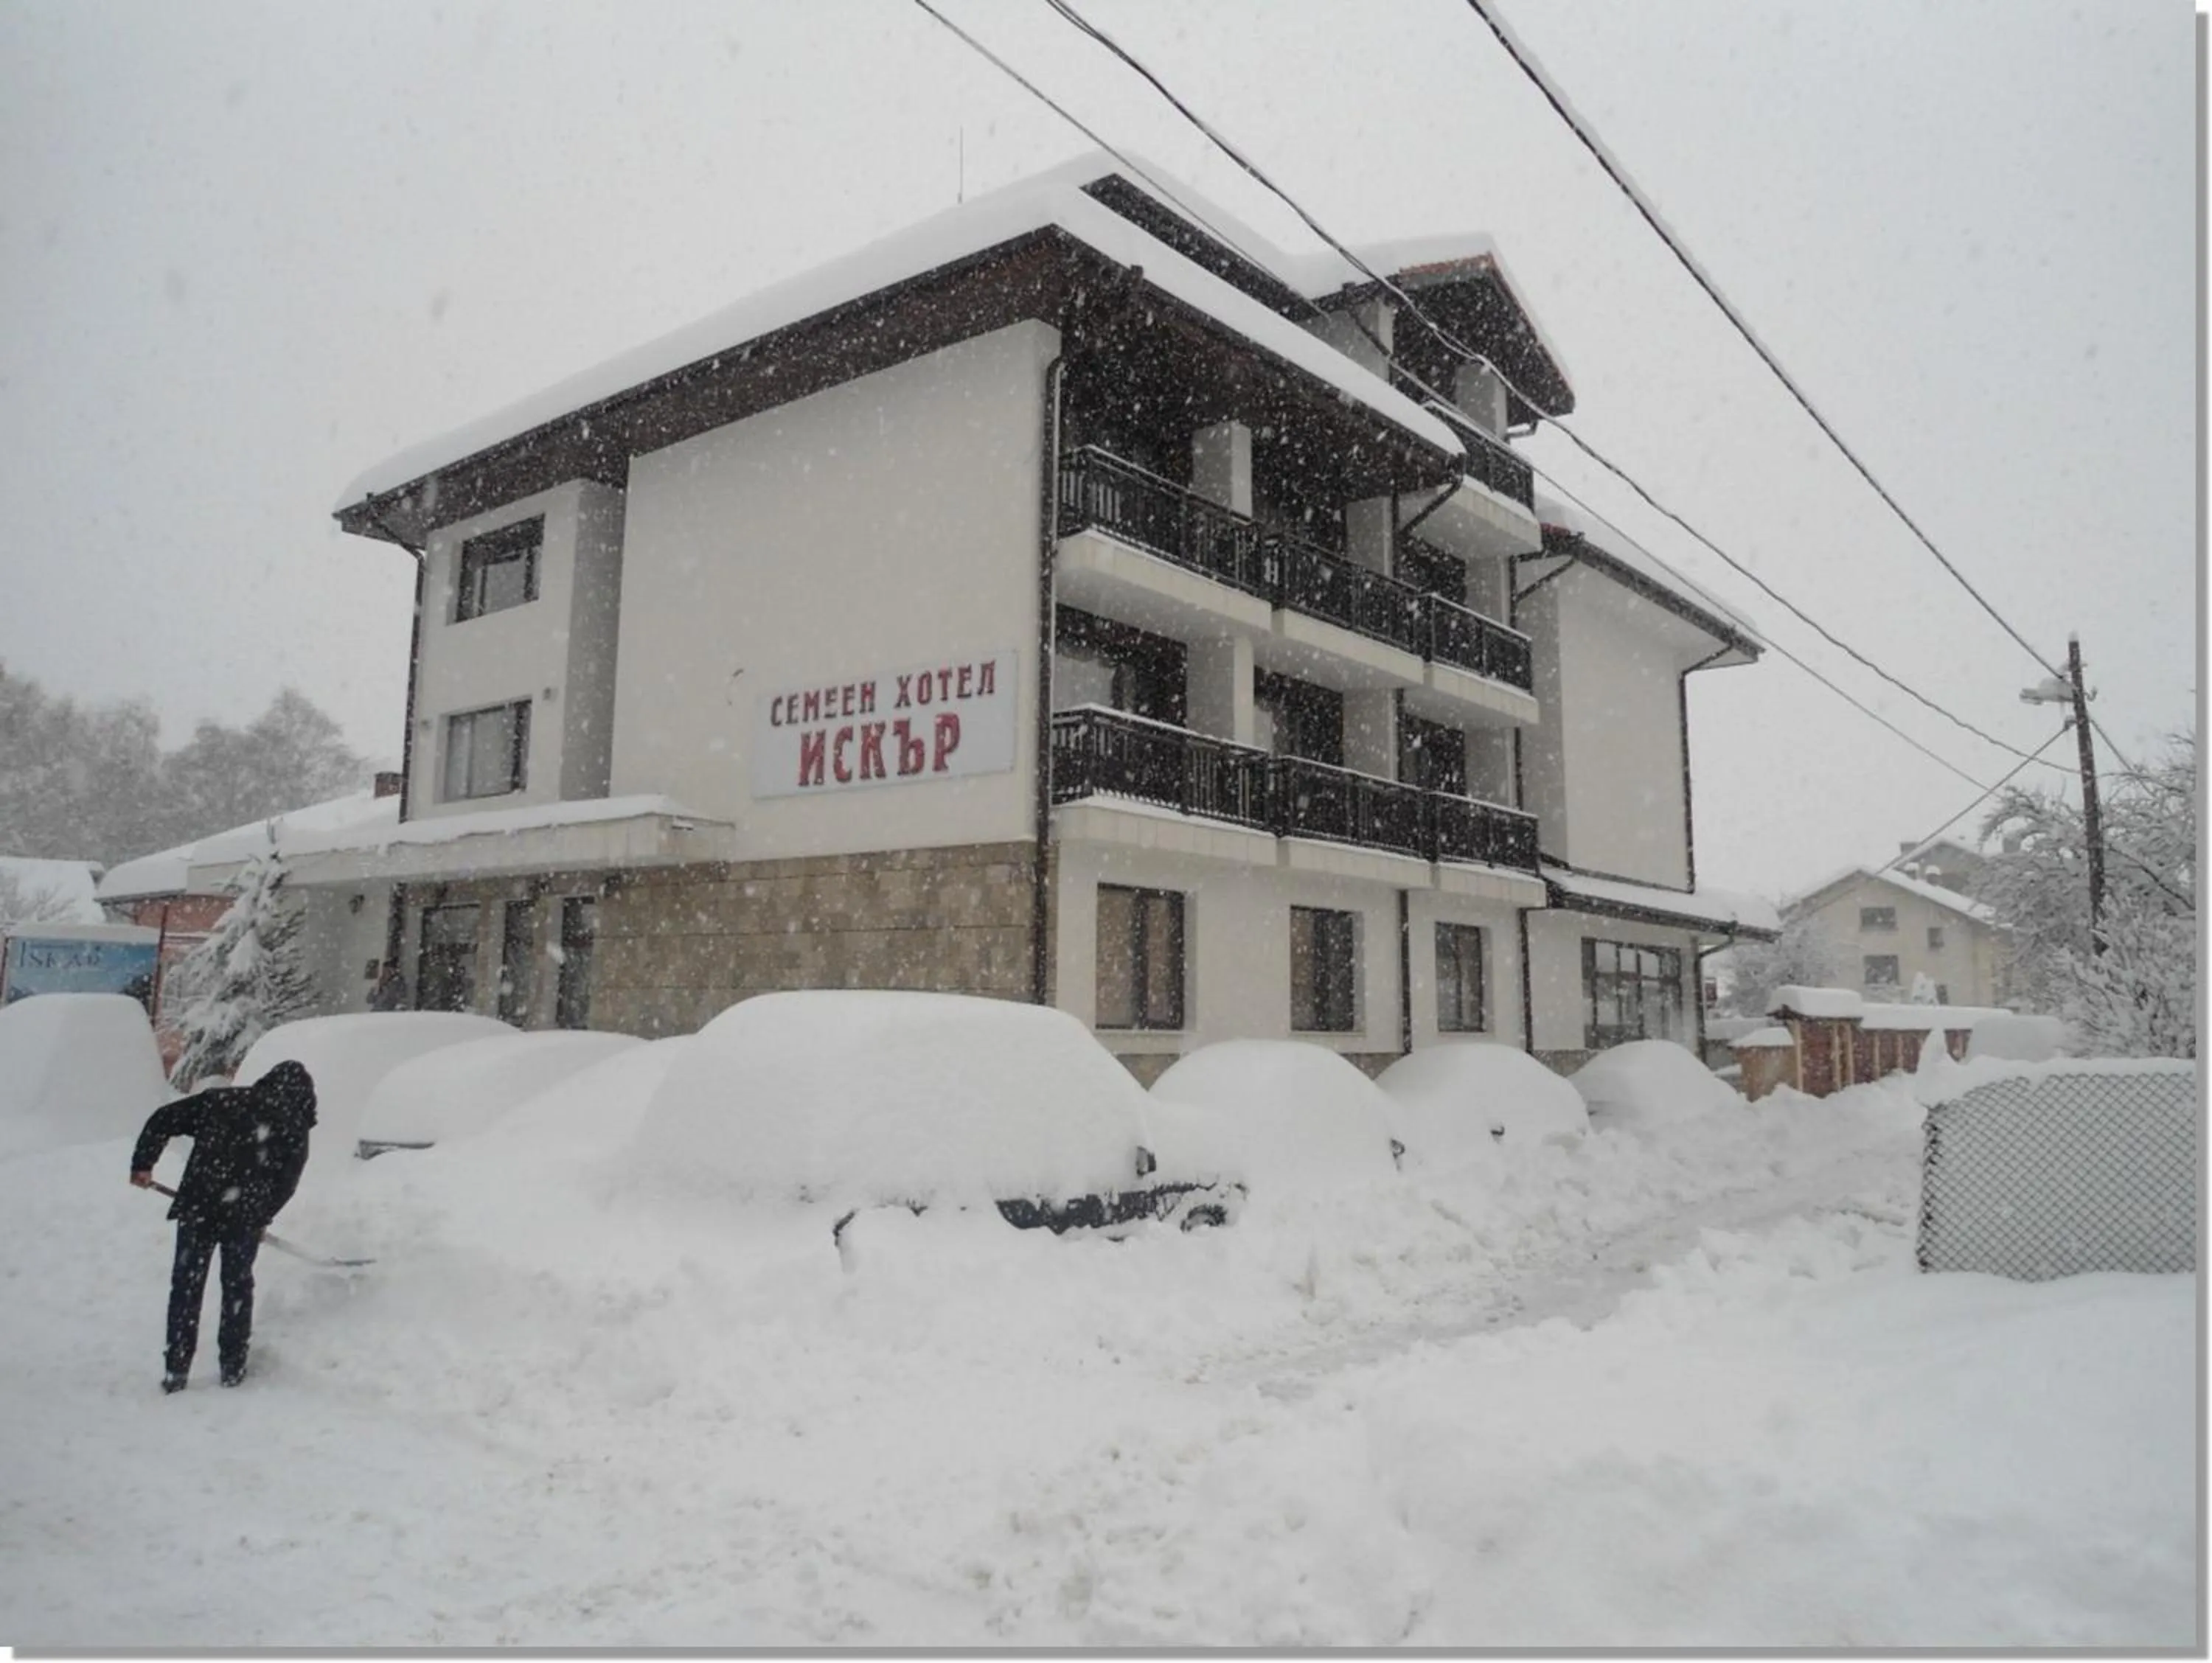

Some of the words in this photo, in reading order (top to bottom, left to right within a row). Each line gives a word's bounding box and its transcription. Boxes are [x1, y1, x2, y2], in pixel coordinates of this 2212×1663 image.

[770, 681, 877, 727] СЕМЕЕН
[894, 660, 996, 708] ХОТЕЛ
[798, 713, 961, 787] ИСКЪР
